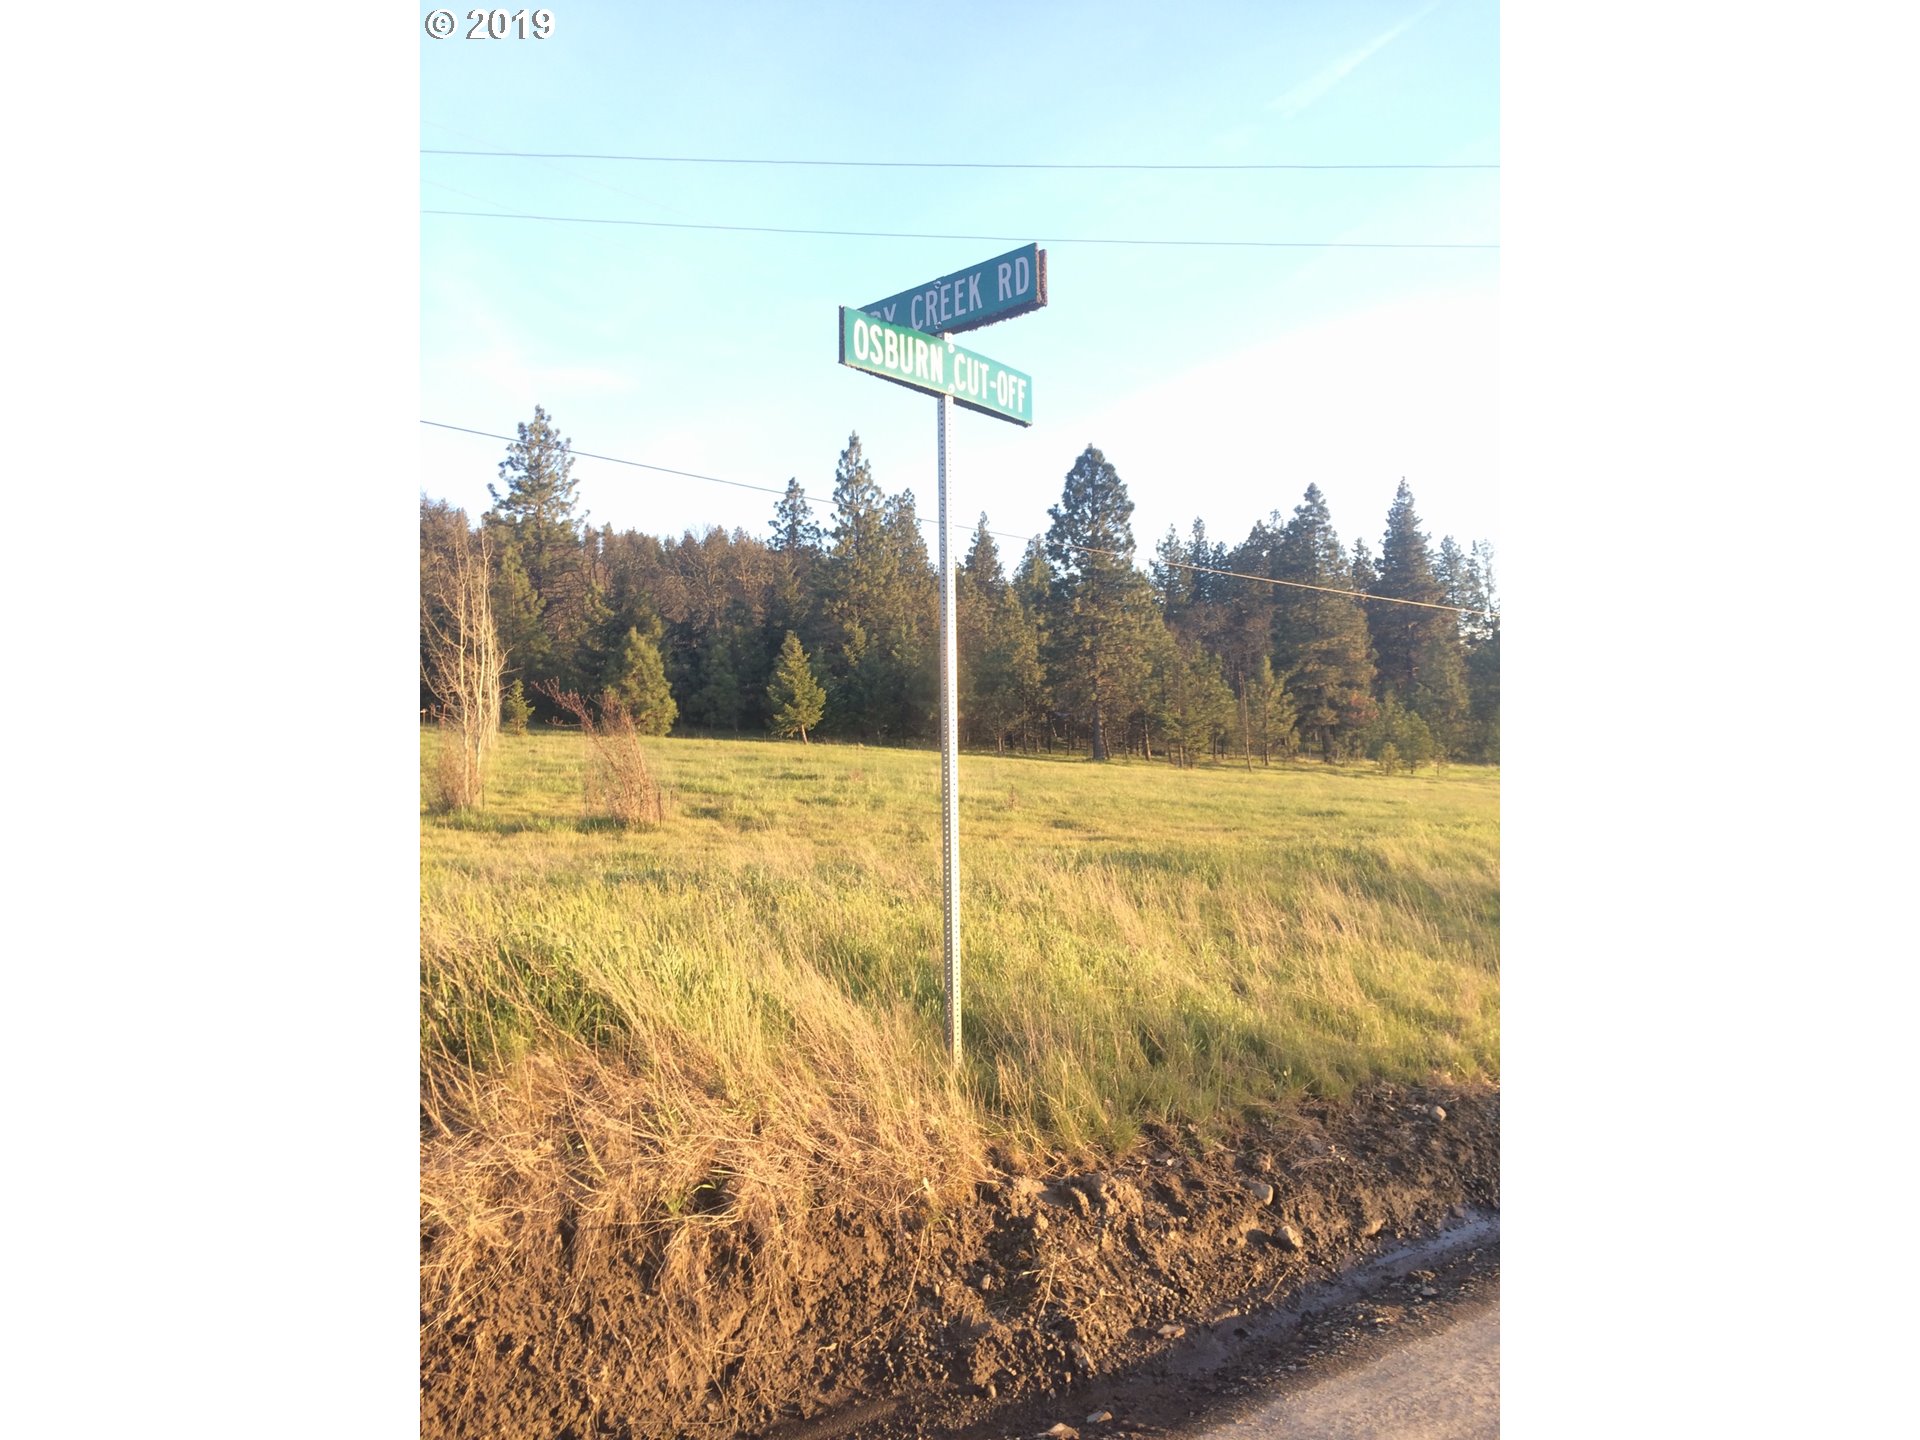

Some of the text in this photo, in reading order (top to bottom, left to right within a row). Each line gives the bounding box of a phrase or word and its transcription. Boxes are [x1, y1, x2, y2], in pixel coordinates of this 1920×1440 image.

[911, 272, 983, 331] CREEK
[997, 256, 1030, 301] RD
[853, 318, 1027, 414] OSBURN CUT-OFF
